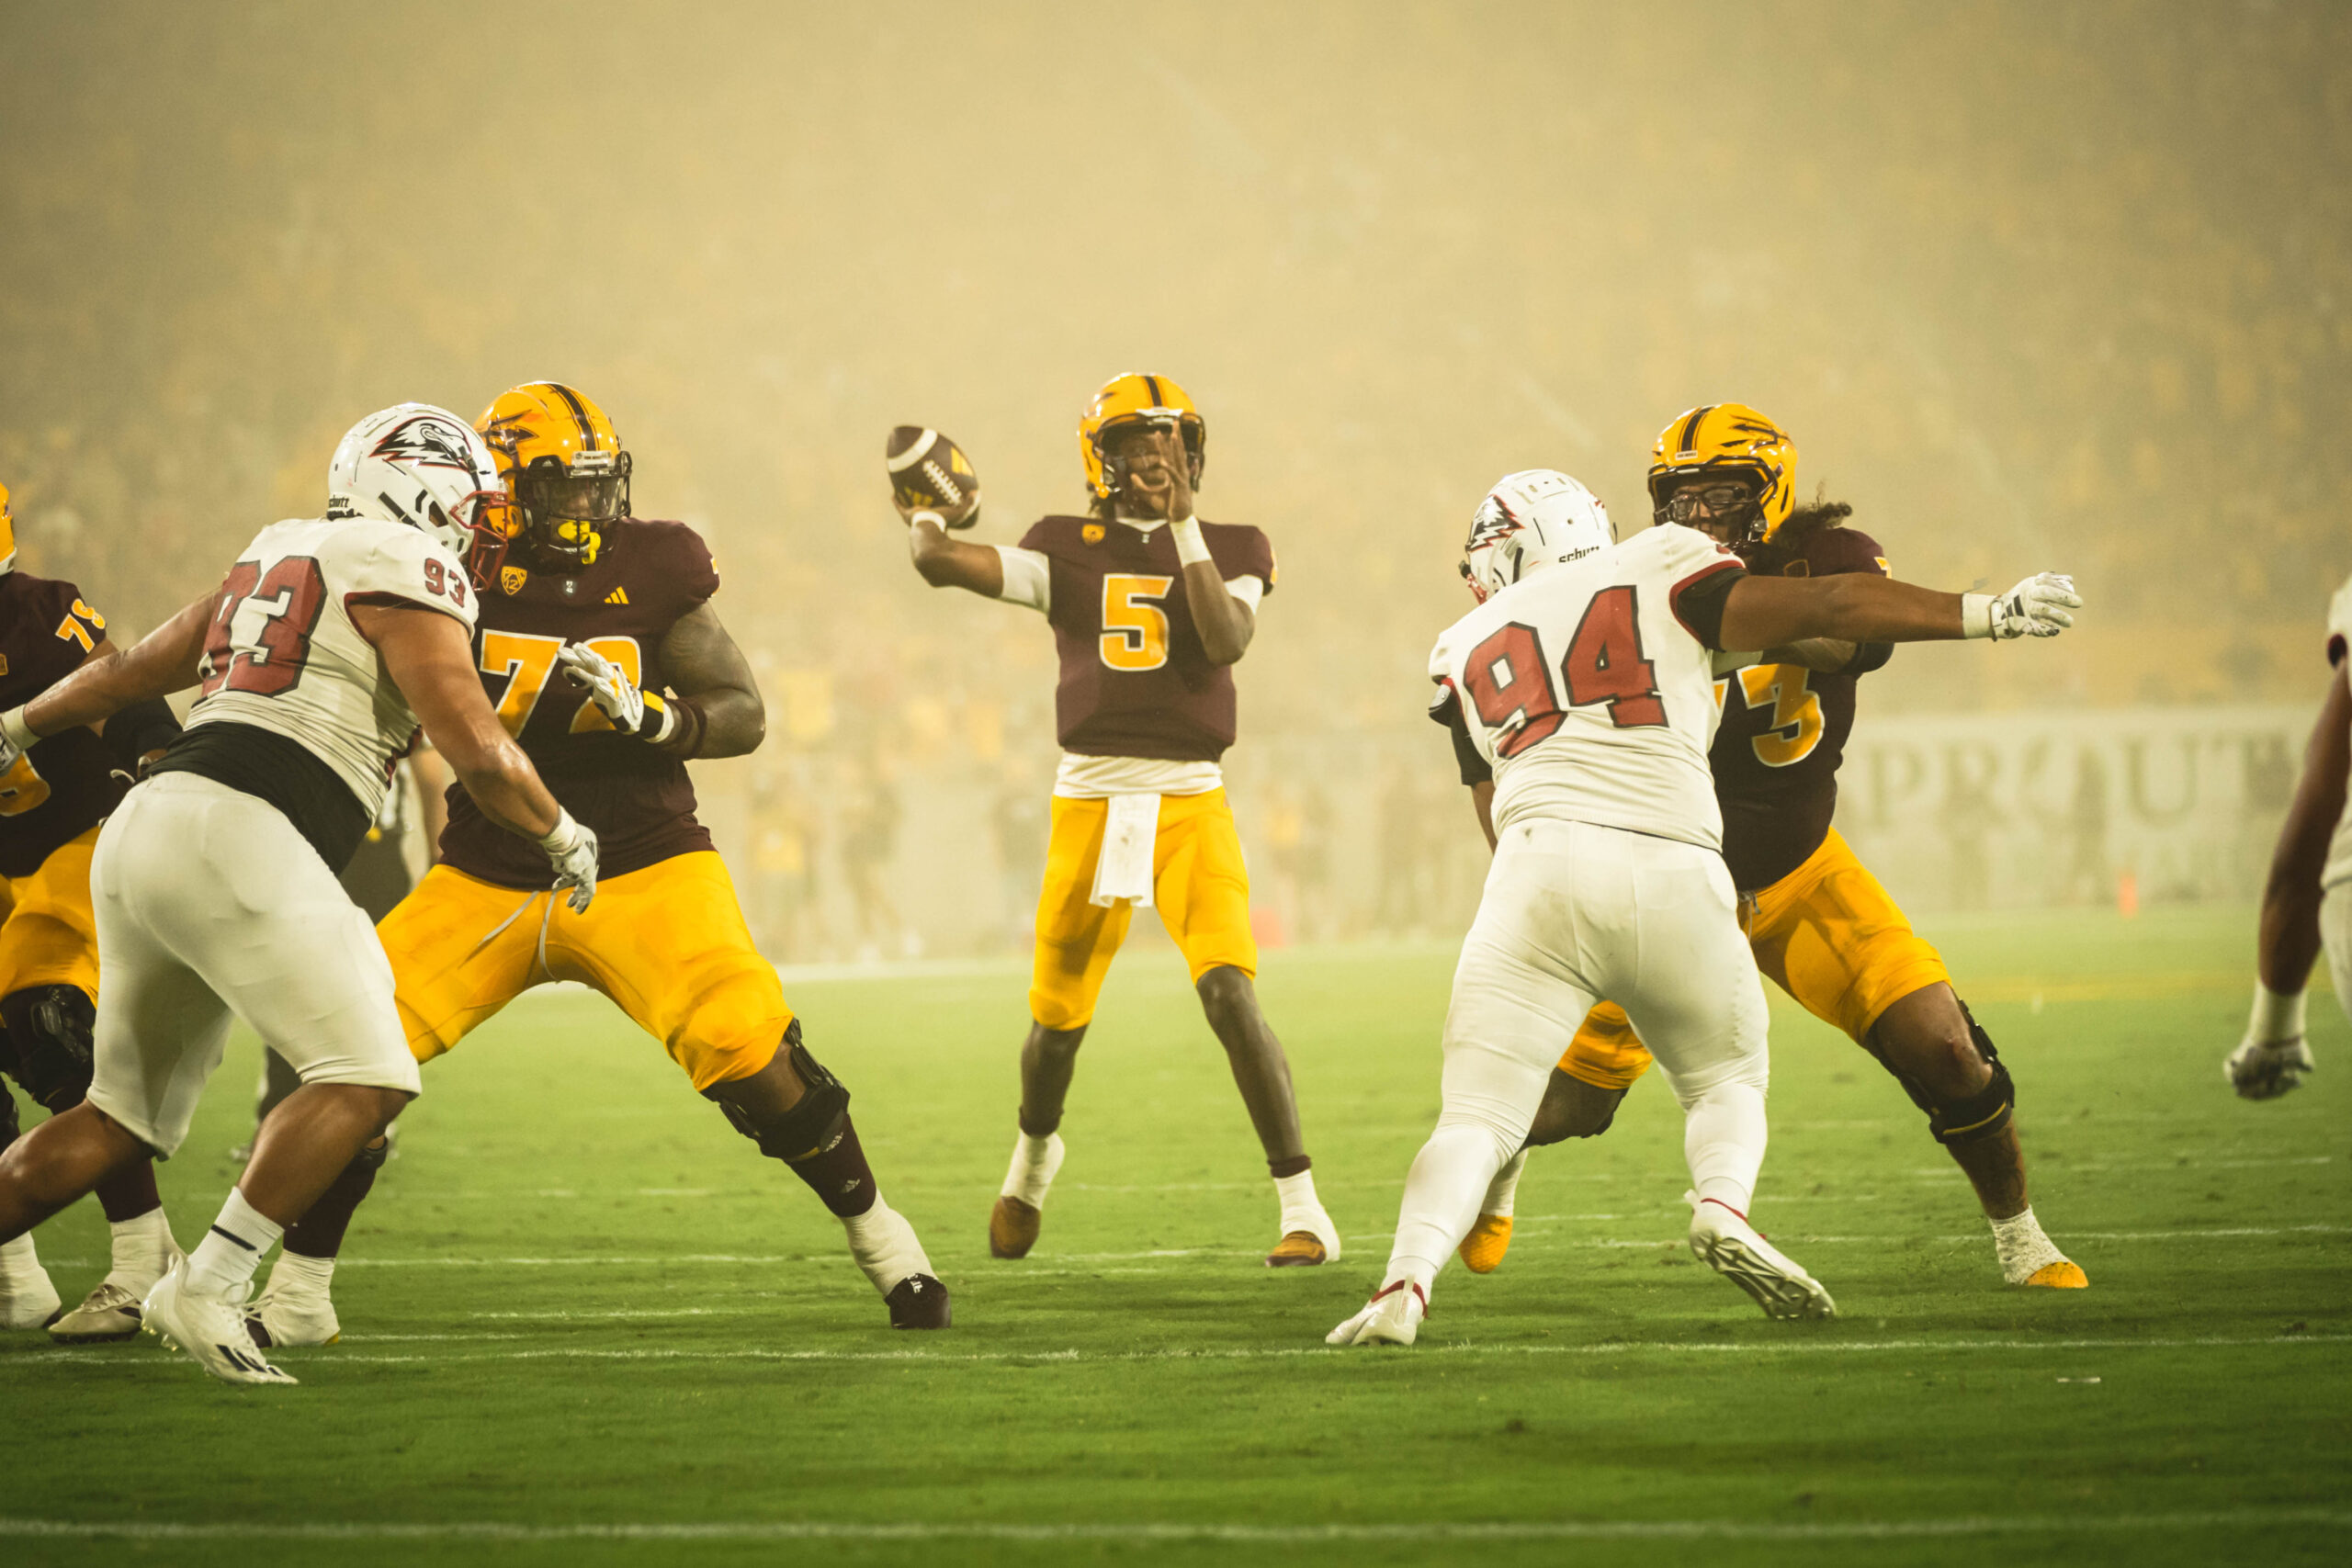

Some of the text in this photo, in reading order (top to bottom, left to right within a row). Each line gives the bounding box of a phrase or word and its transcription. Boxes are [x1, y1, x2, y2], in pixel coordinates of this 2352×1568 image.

[195, 555, 328, 700] 93
[424, 557, 467, 609] 93
[1099, 573, 1174, 671] 5
[1463, 584, 1670, 761] 94
[1713, 662, 1826, 768] 3
